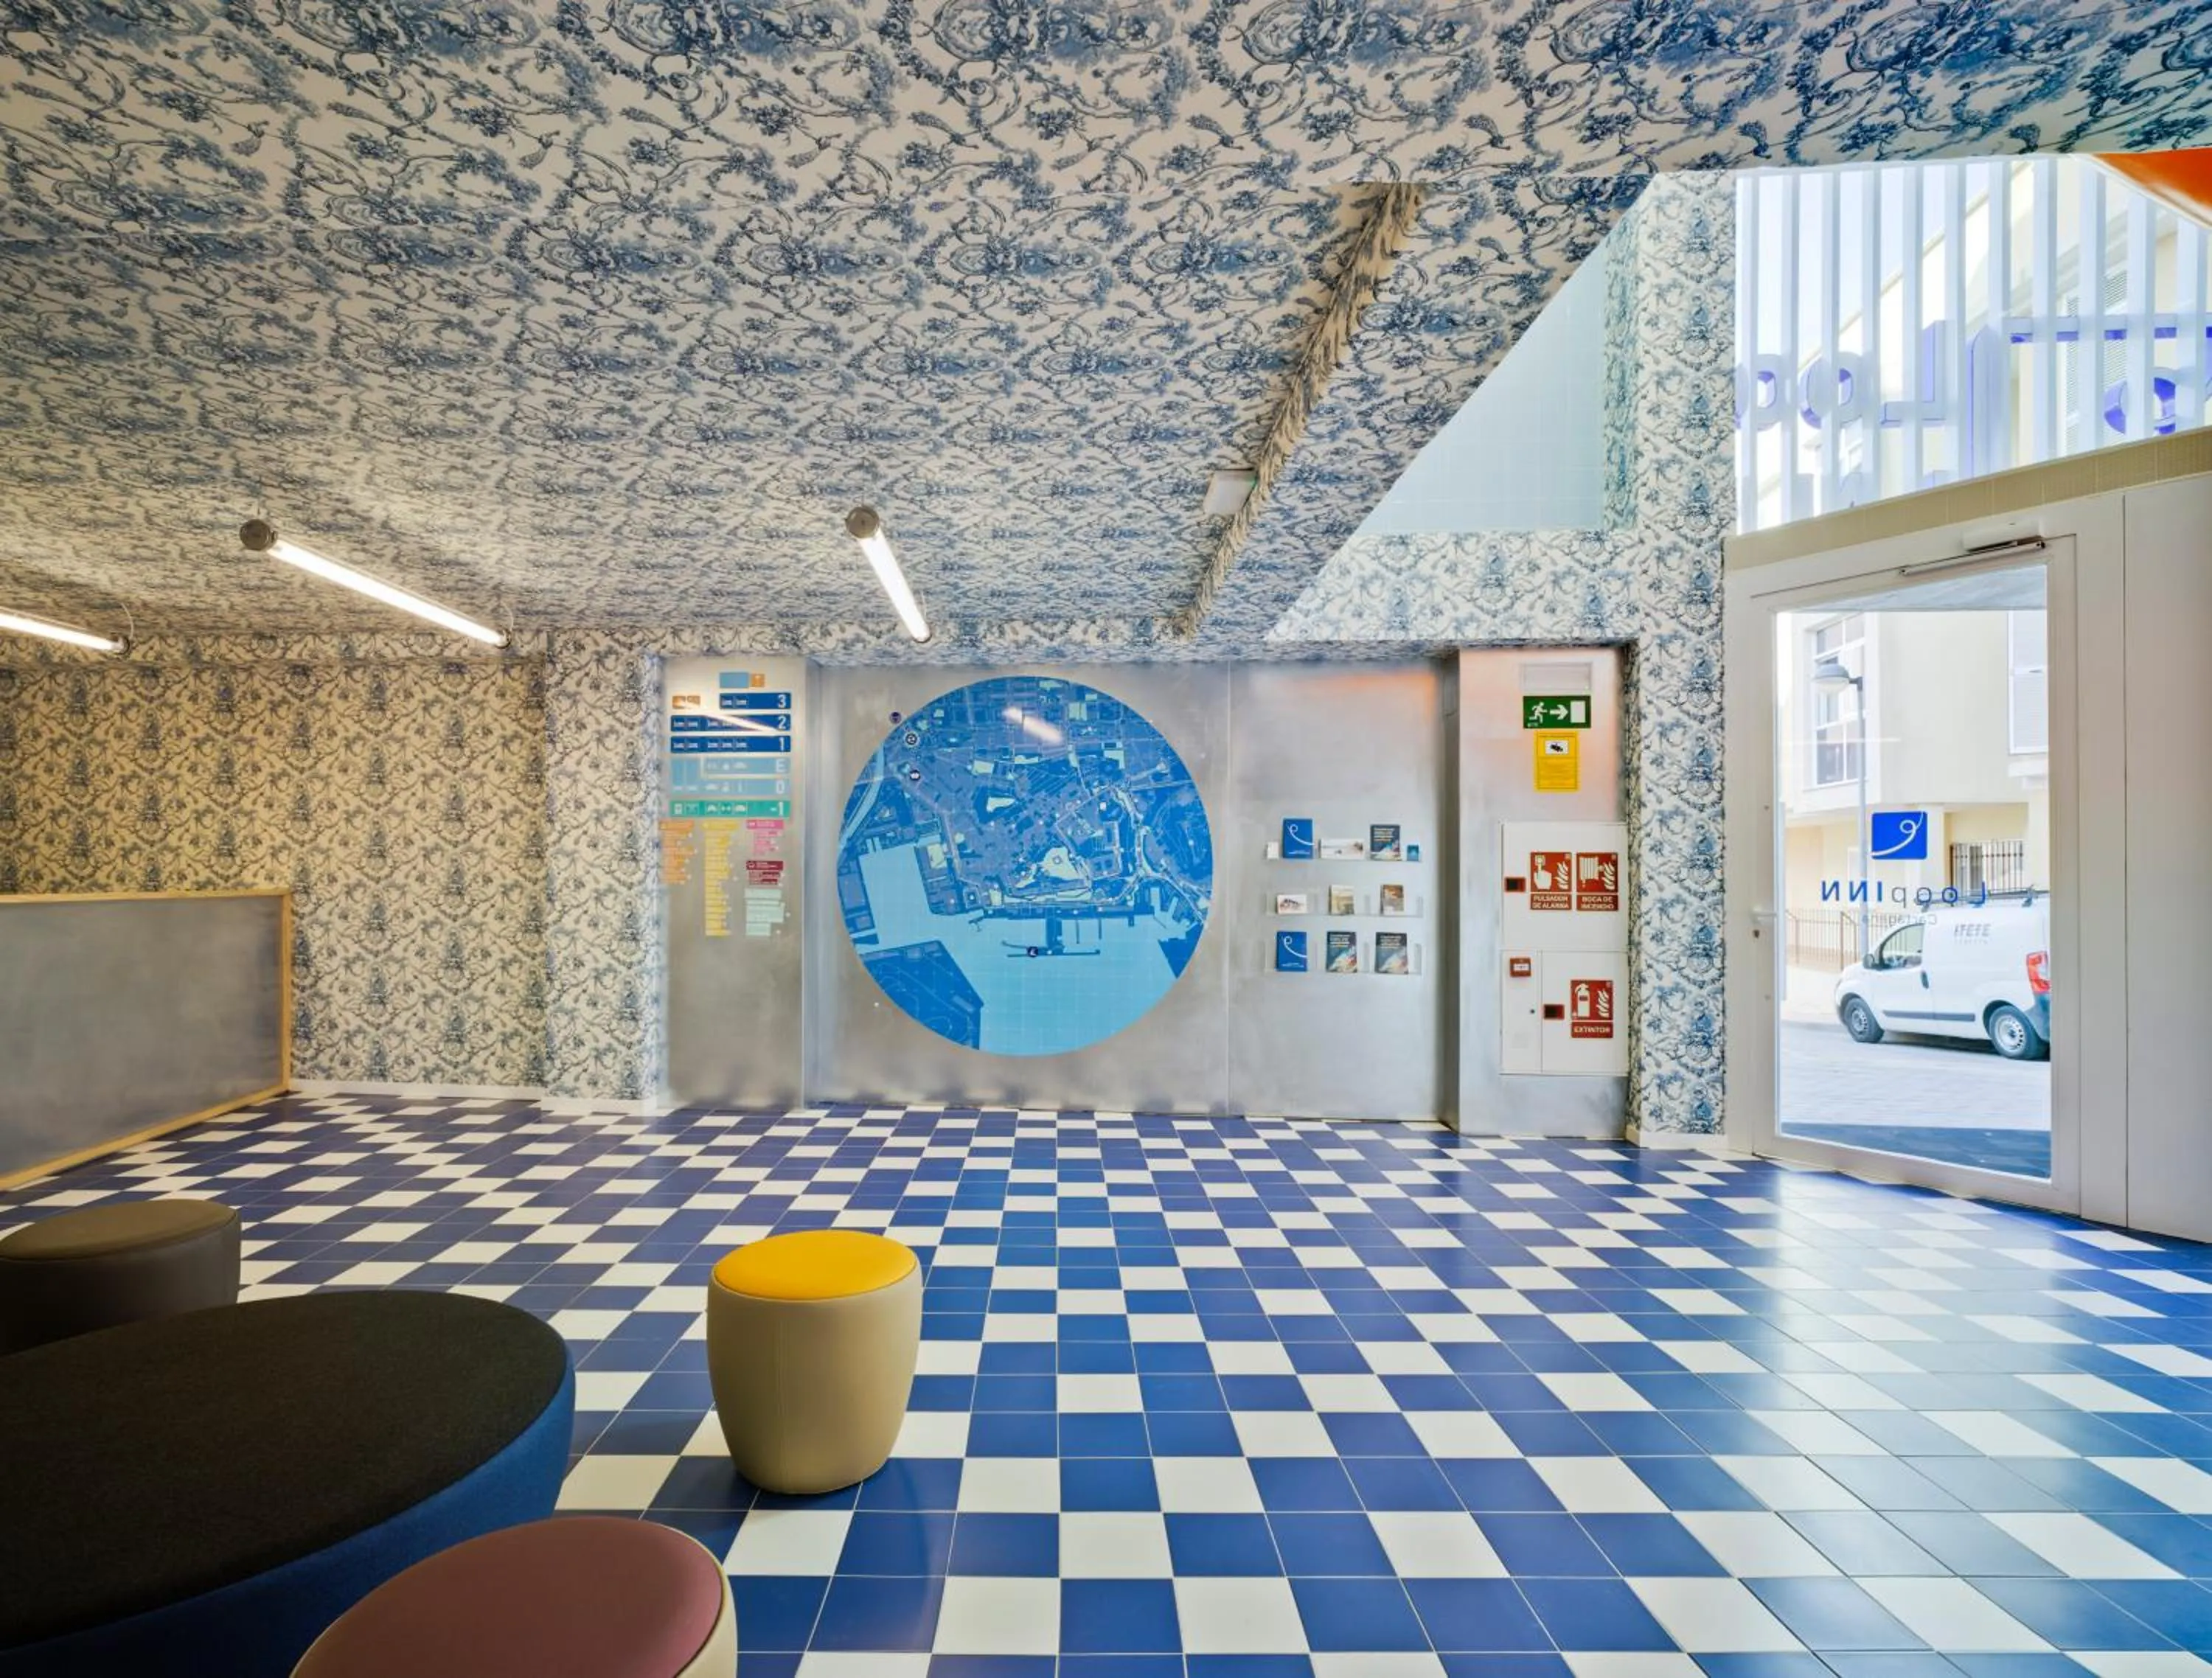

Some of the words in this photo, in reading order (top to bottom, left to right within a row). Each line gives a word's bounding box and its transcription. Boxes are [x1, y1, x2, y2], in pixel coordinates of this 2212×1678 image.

[778, 694, 786, 708] 3
[778, 717, 786, 729] 2
[779, 737, 785, 751] 1
[776, 759, 785, 773] E
[770, 801, 784, 815] -1
